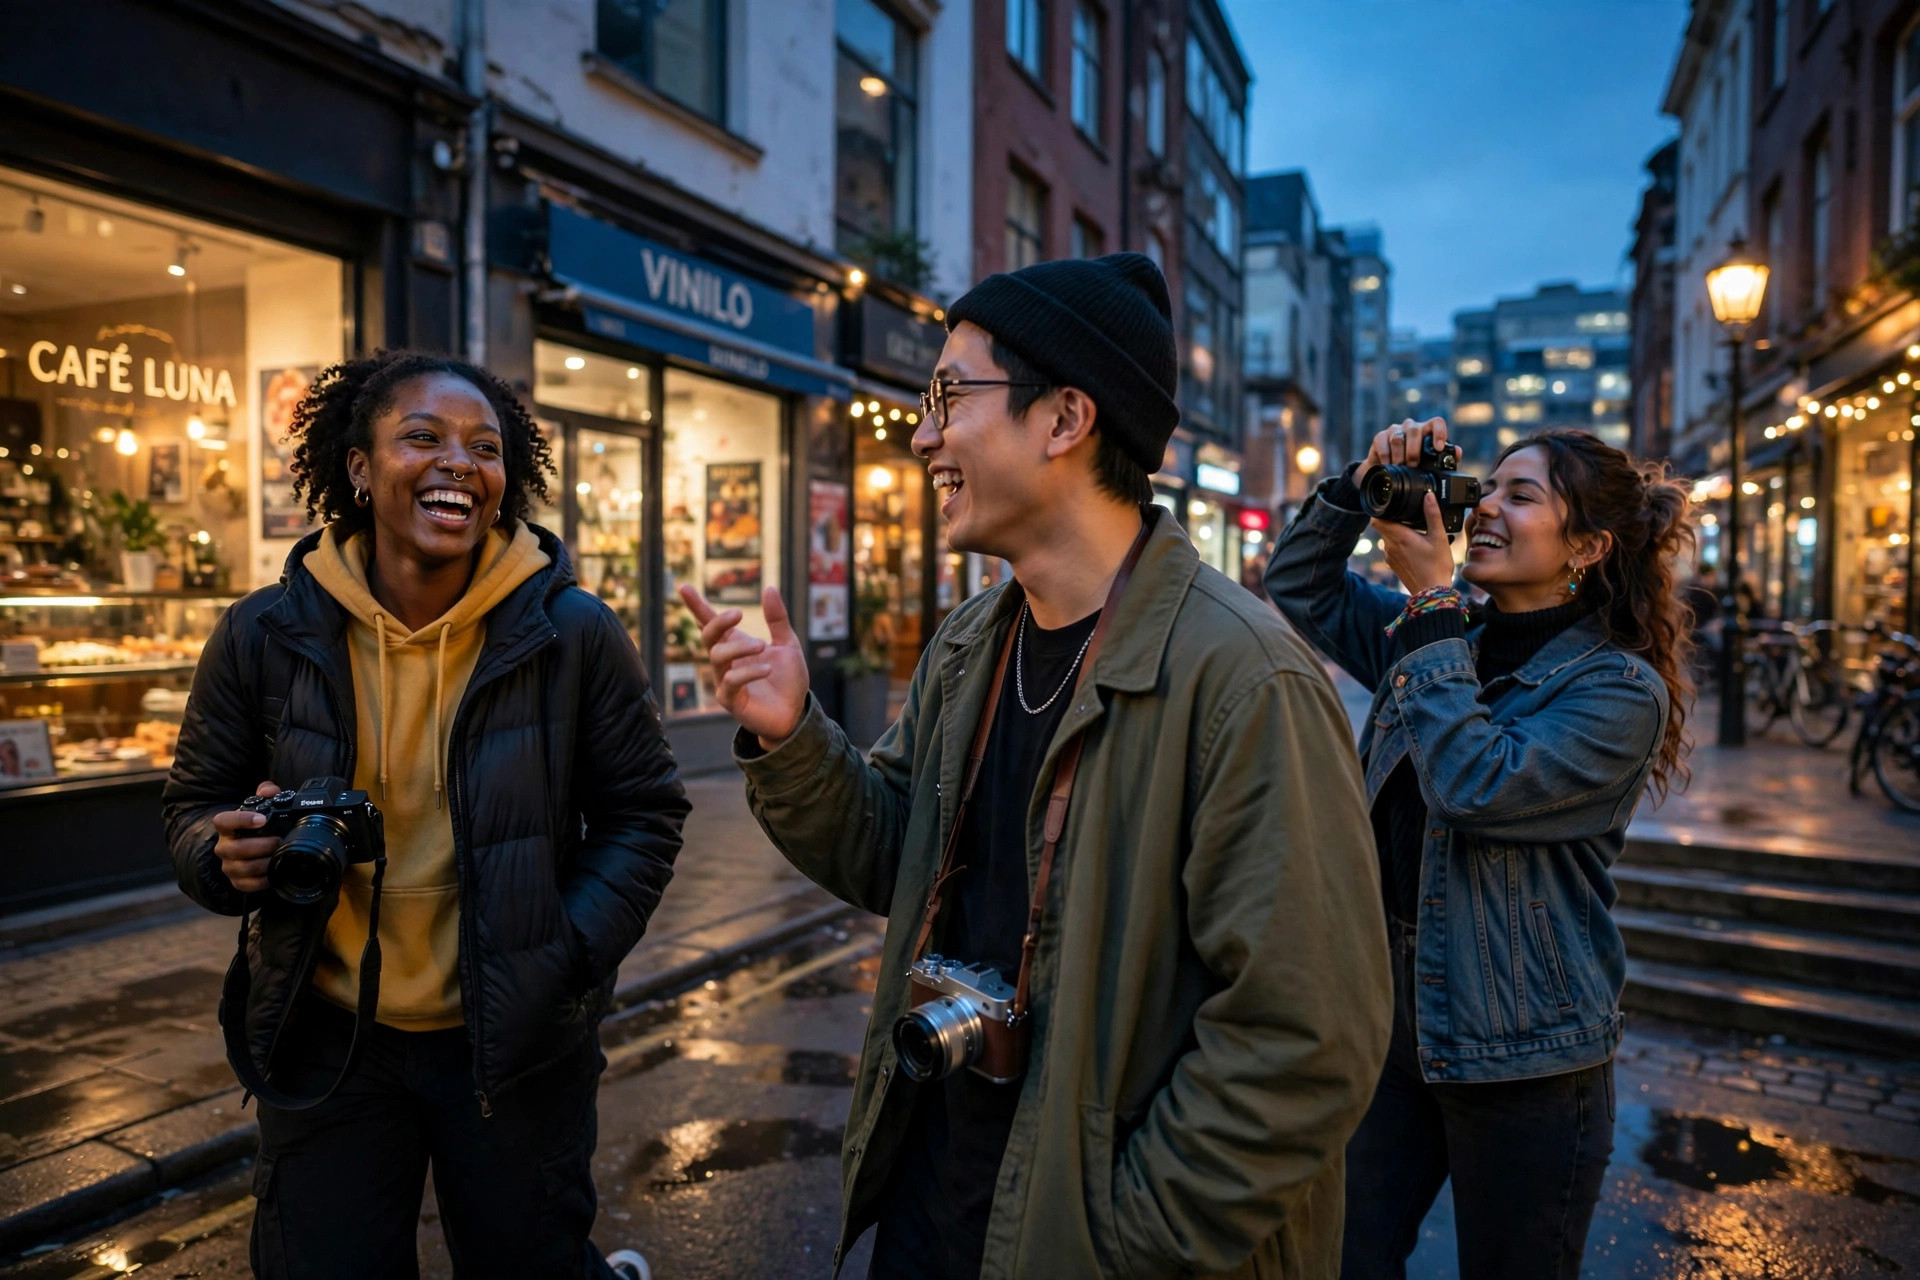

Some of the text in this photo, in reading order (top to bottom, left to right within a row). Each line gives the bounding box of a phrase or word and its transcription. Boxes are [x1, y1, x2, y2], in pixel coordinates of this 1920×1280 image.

[641, 247, 753, 329] VINILO
[28, 340, 237, 408] CAFÉ LUNA
